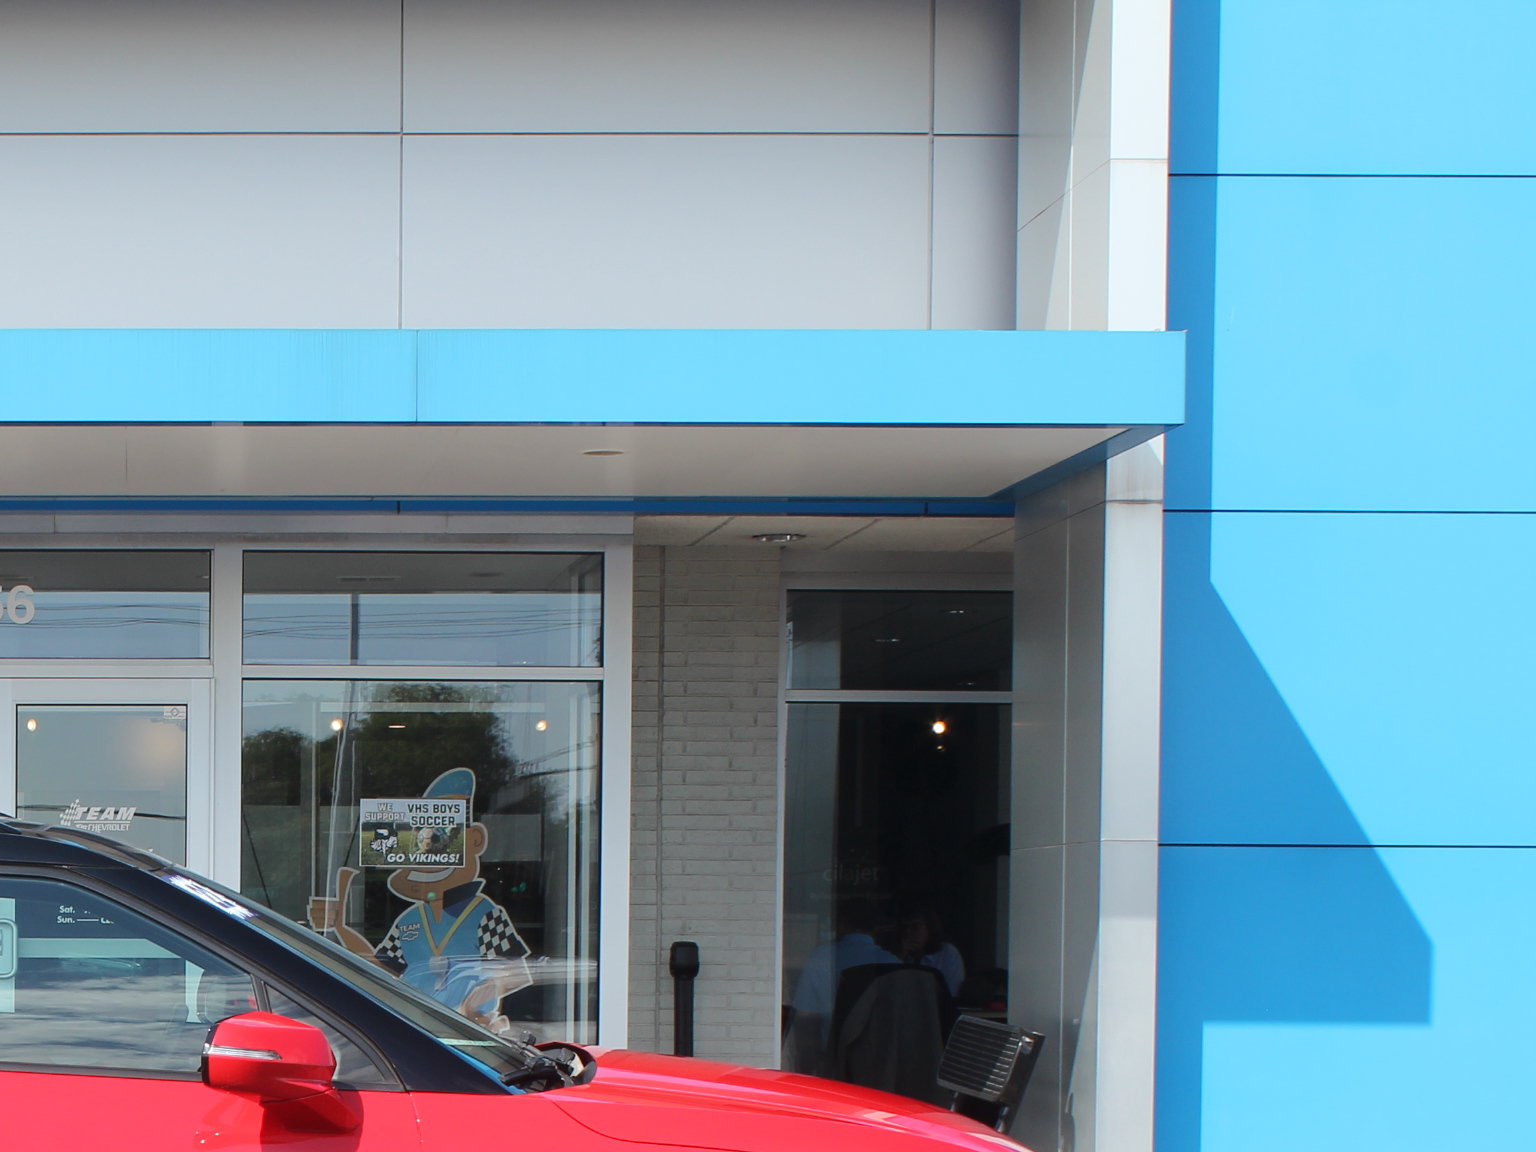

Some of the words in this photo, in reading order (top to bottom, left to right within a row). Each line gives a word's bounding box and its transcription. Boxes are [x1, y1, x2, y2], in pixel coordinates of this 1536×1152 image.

[377, 803, 393, 812] WE
[408, 804, 428, 813] VHS
[433, 804, 460, 813] BOYS
[74, 806, 137, 820] TEAM
[364, 812, 405, 821] SUPPORT
[411, 816, 455, 826] SOCCER
[387, 853, 405, 863] GO
[408, 853, 460, 863] VIKINGS!
[59, 905, 76, 914] Sat.
[57, 915, 76, 924] Sun.
[399, 924, 420, 932] TEAM
